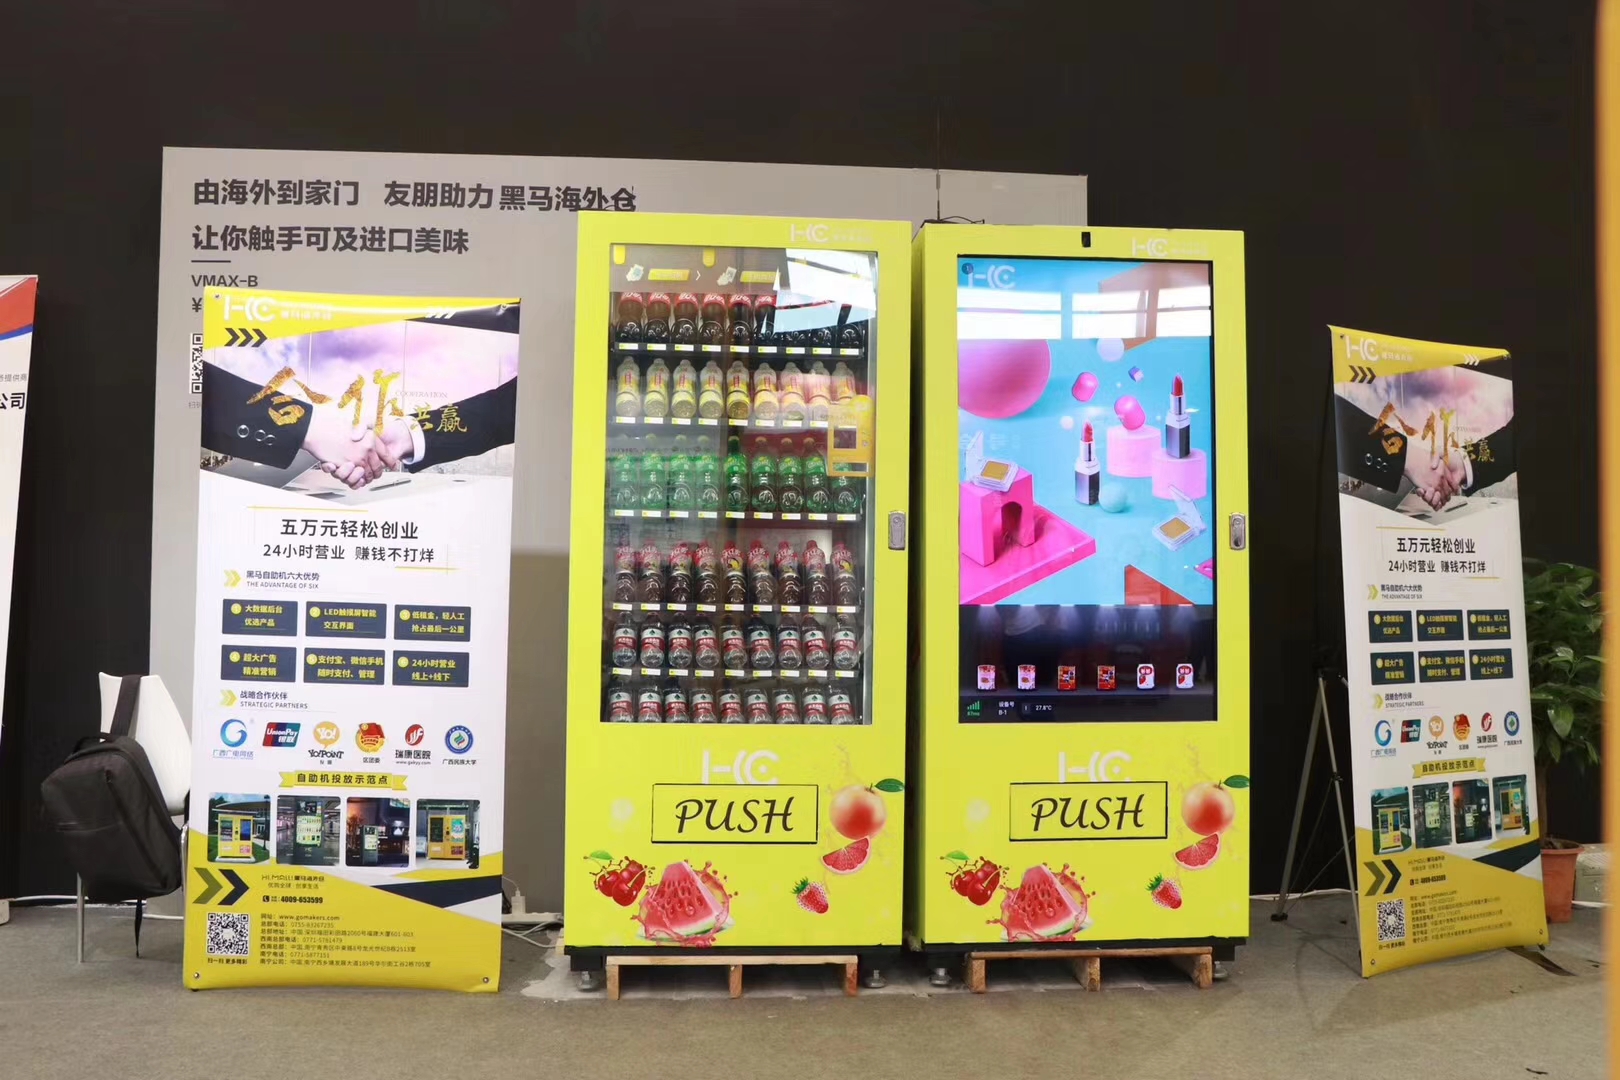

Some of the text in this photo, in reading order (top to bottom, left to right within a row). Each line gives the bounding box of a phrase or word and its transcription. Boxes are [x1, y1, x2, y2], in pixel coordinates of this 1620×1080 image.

[194, 179, 636, 212] 由海外到家门 友朋助力 黑马海外仓
[192, 224, 469, 254] 让你触手可及进口美味
[191, 274, 258, 287] VMAX-B
[280, 518, 418, 540] 五万元轻松创业
[1397, 538, 1475, 554] 五万元轻松创业
[263, 544, 434, 563] 24小时营业 赚钱不打烊
[1389, 560, 1486, 573] 24小时营业 赚钱不打烊
[246, 570, 320, 580] 黑马自助机六大优势
[245, 604, 282, 614] 大数据后台
[324, 608, 377, 618] LED触摸屏智能
[245, 618, 275, 627] 优选产品
[324, 621, 354, 630] 交互界面
[412, 624, 465, 634] 抢占最后一公里
[243, 653, 276, 663] 超大广告
[318, 655, 384, 666] 支付宝、微信手机
[412, 659, 456, 668] 24小时营业
[243, 666, 276, 676] 精准营销
[317, 668, 376, 679] 随时支付、管理
[412, 671, 450, 681] 线上+线下
[240, 690, 288, 700] 战略合作伙伴
[267, 728, 298, 736] UnionPay
[395, 750, 431, 759] 瑞康医院
[1422, 760, 1475, 773] 自助机投放示范点
[297, 773, 388, 784] 自助机投放示范点
[675, 796, 794, 834] PUSH
[1031, 794, 1144, 831] PUSH
